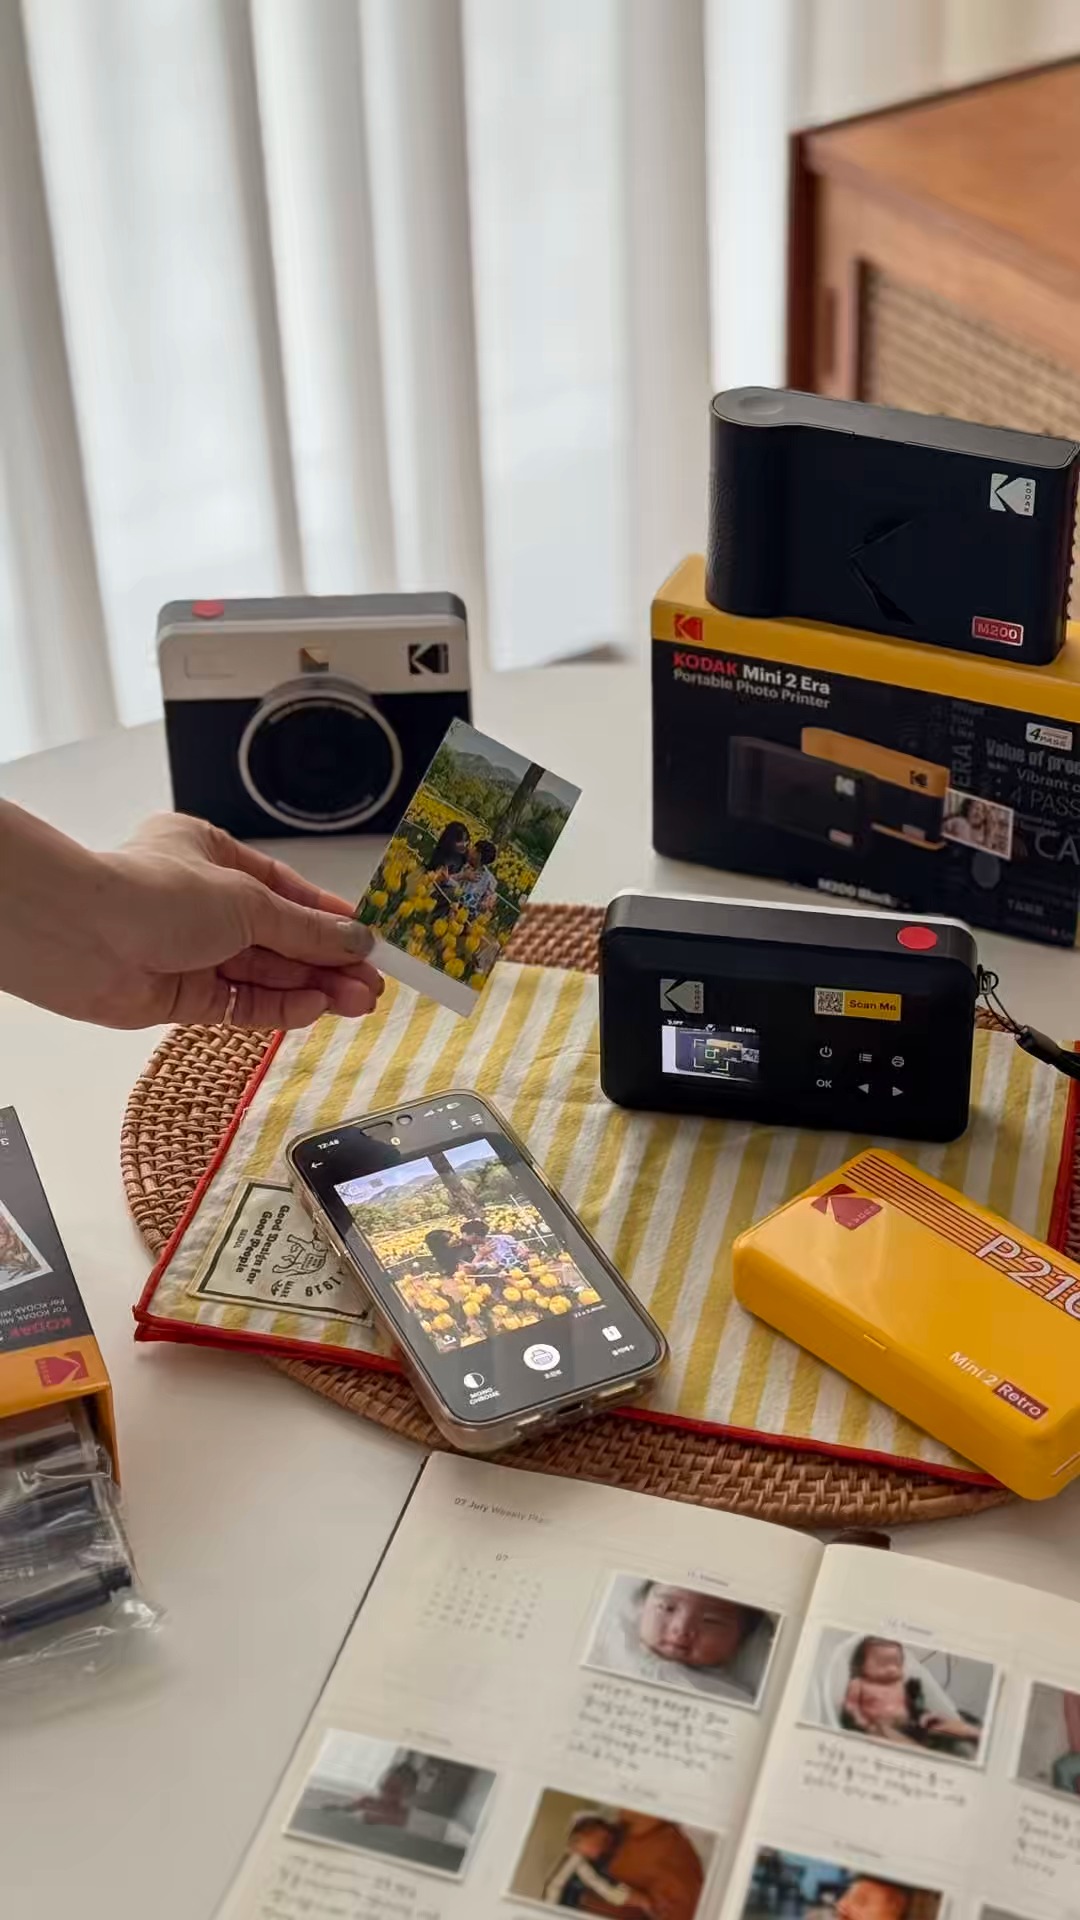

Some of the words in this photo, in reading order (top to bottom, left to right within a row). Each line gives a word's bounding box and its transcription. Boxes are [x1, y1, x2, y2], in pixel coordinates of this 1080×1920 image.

[977, 622, 1018, 641] M200
[672, 652, 738, 676] KODAK
[742, 663, 782, 686] Mini
[785, 673, 798, 688] 2
[800, 676, 831, 696] Era
[673, 668, 734, 690] Portable
[736, 679, 779, 699] Photo
[780, 688, 831, 709] Printer
[986, 737, 1026, 764] Value
[1016, 767, 1069, 791] Vibrant
[849, 1000, 877, 1010] Scan
[879, 1002, 897, 1011] Me
[816, 1079, 833, 1089] OK
[253, 1211, 273, 1237] Good
[272, 1205, 291, 1232] Good
[235, 1238, 262, 1273] People
[246, 1268, 262, 1285] for
[13, 1303, 48, 1315] KODAK
[15, 1309, 51, 1321] KODAK
[52, 1305, 68, 1313] For
[949, 1351, 987, 1378] Mini
[982, 1374, 998, 1387] 2
[996, 1383, 1042, 1416] Retro
